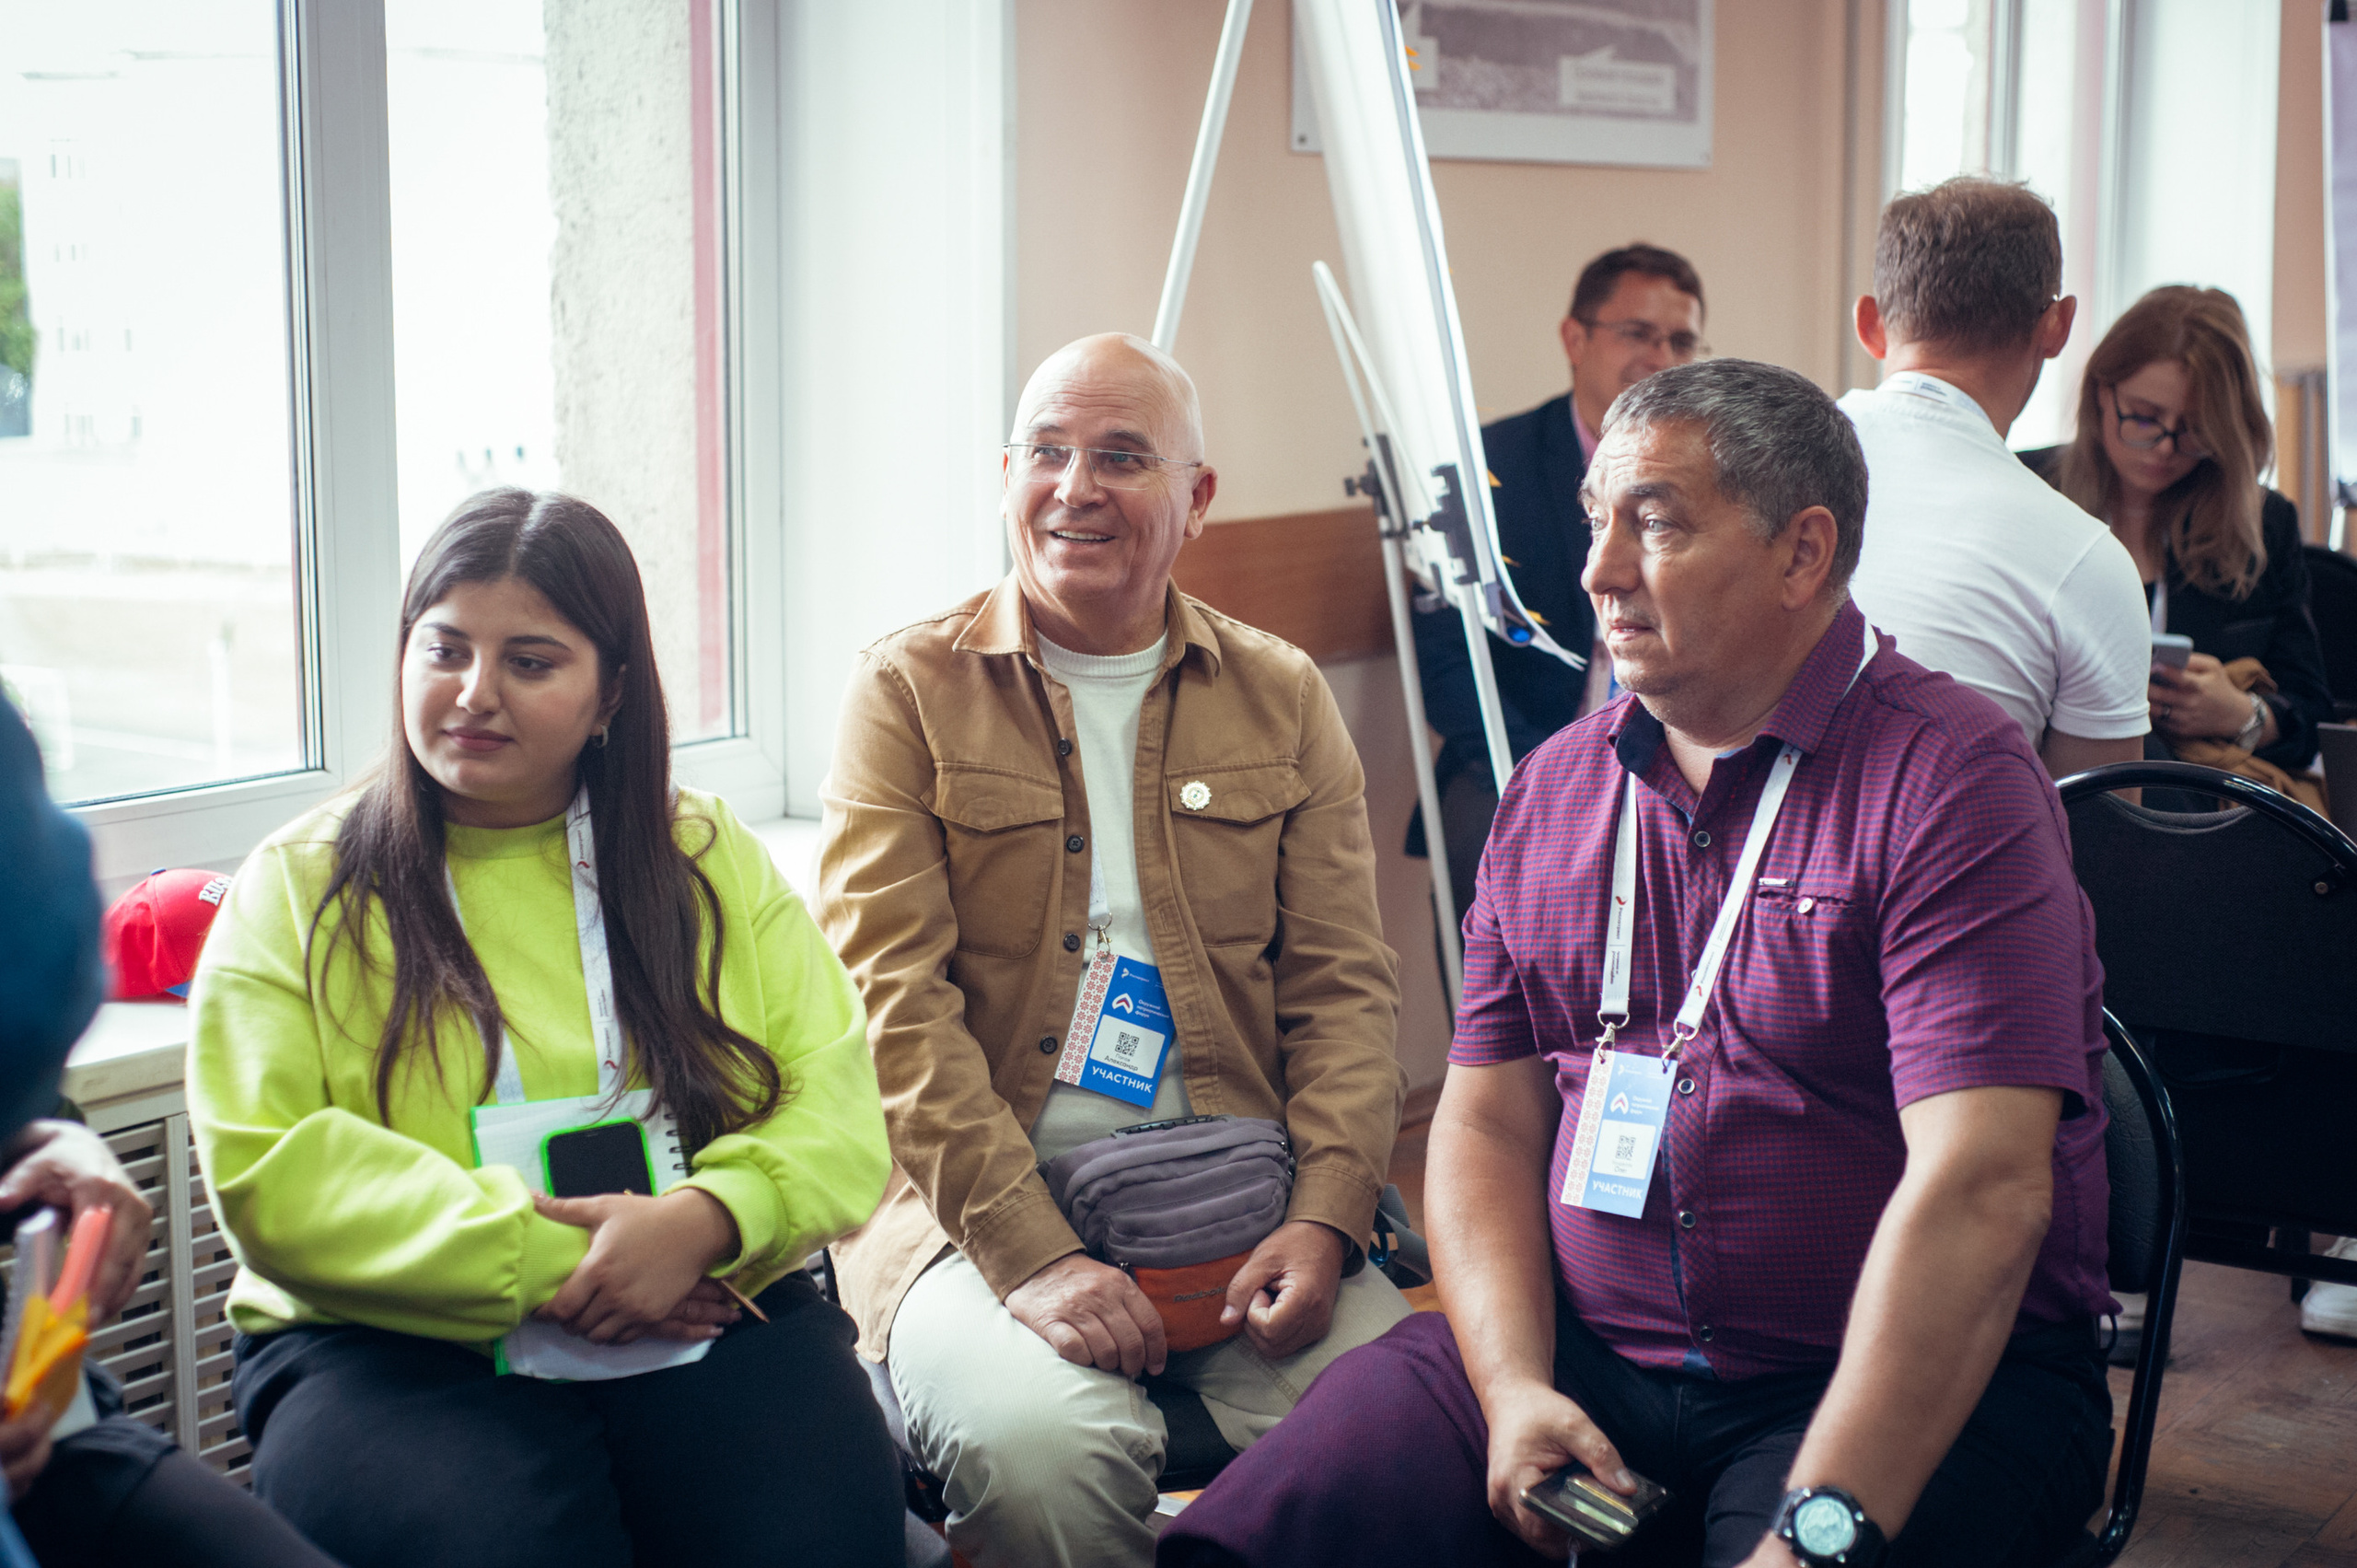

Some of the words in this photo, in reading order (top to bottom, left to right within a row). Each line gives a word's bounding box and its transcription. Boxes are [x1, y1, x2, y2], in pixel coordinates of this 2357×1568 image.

[1104, 1055, 1138, 1072] Александр
[1092, 1065, 1153, 1093] УЧАСТНИК
[1592, 1179, 1643, 1201] УЧАСТНИК
